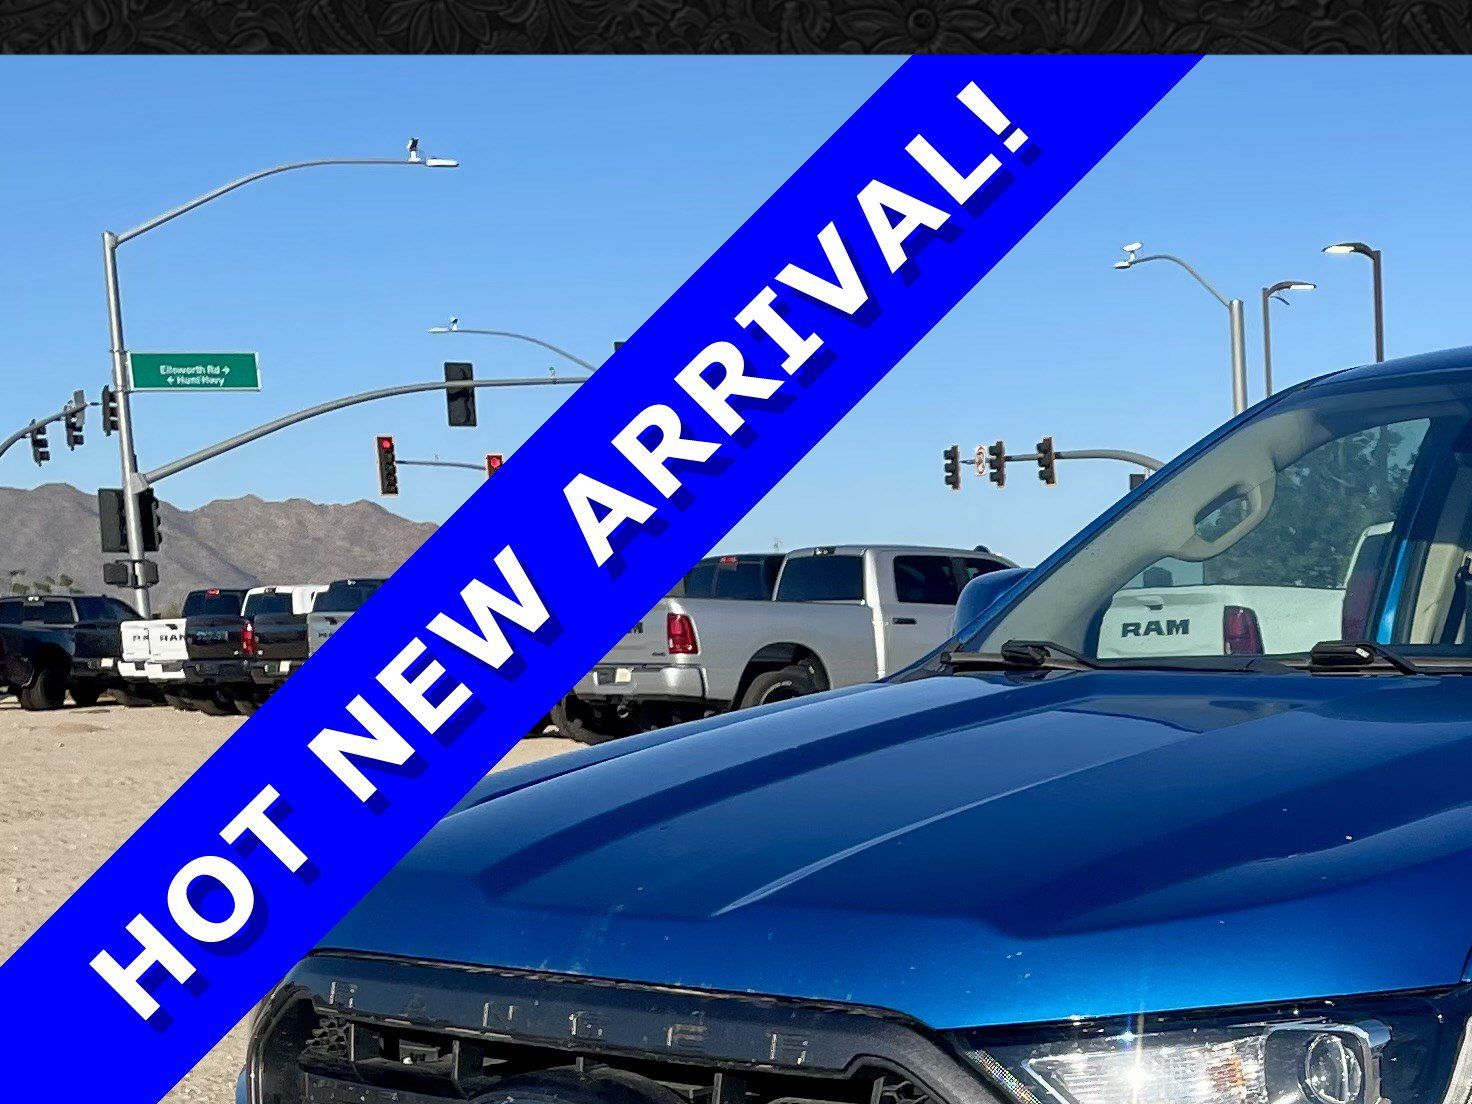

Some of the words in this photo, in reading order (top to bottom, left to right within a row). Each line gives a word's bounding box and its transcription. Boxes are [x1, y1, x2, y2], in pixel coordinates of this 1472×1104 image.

[159, 364, 206, 375] Ellsworth
[207, 364, 221, 375] Rd
[1121, 618, 1190, 638] RAM
